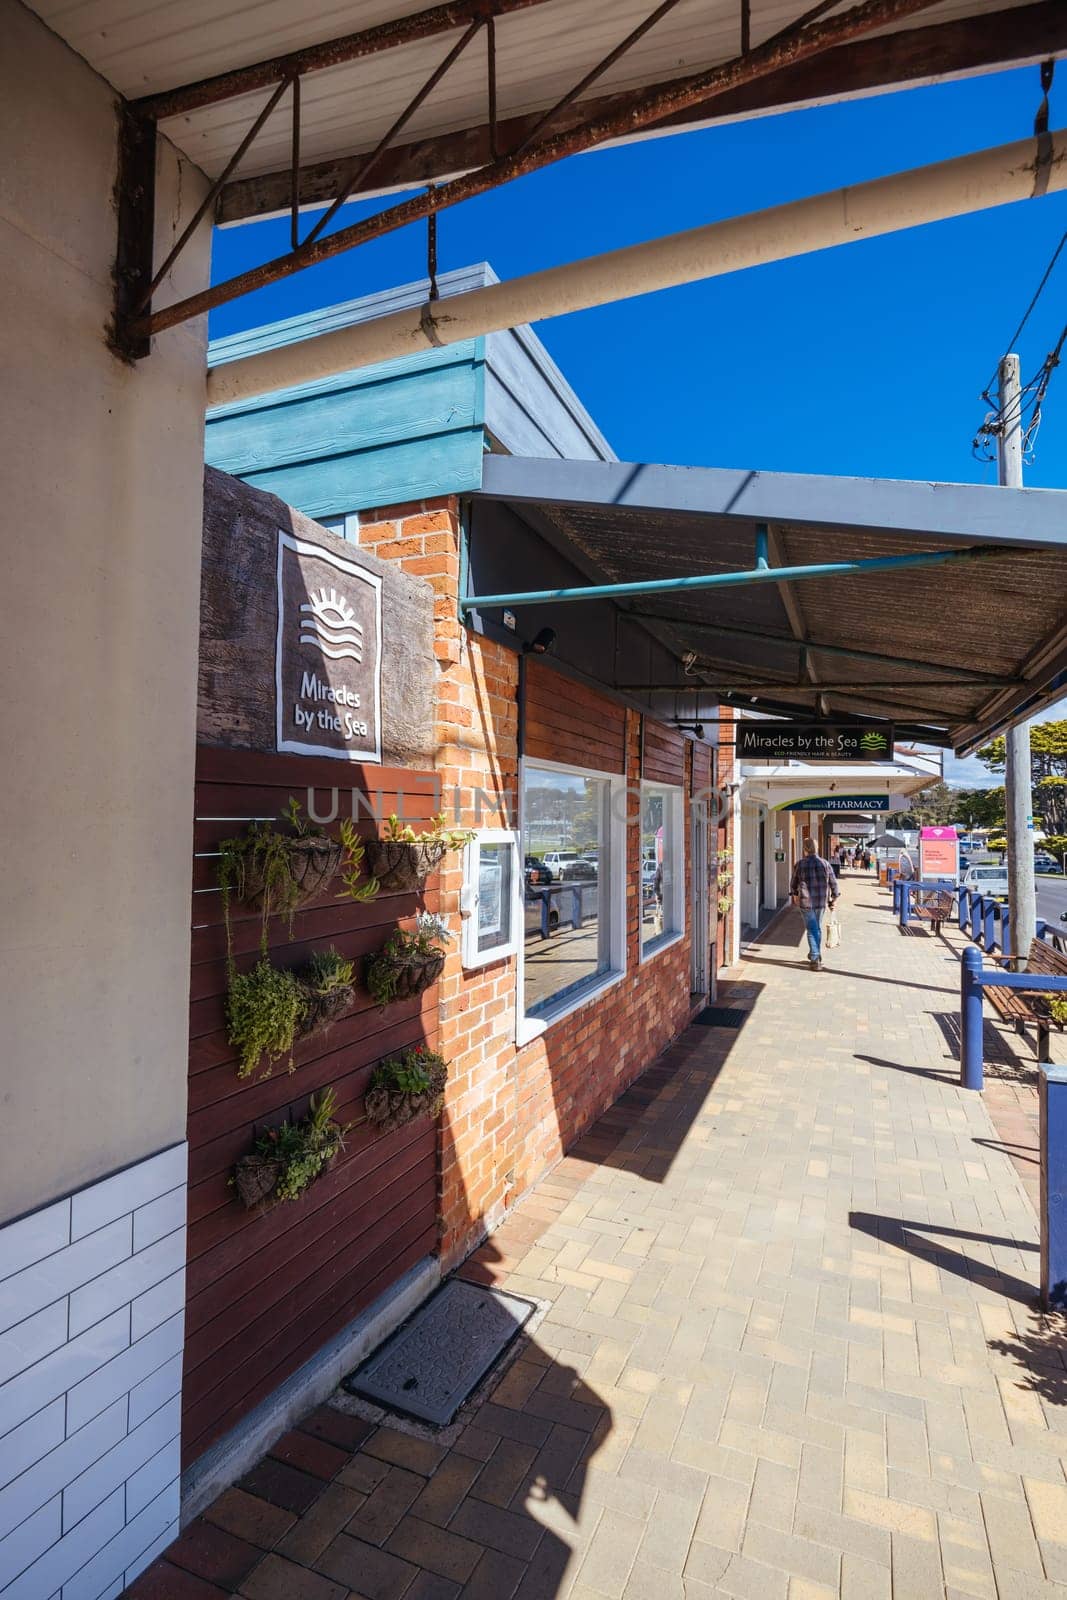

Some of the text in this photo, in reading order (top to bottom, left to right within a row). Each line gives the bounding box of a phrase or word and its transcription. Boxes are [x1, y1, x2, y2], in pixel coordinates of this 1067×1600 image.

[301, 671, 361, 708] Miracles
[295, 703, 368, 740] by the Sea
[743, 733, 858, 751] Miracles by the Sea
[827, 800, 884, 809] PHARMACY
